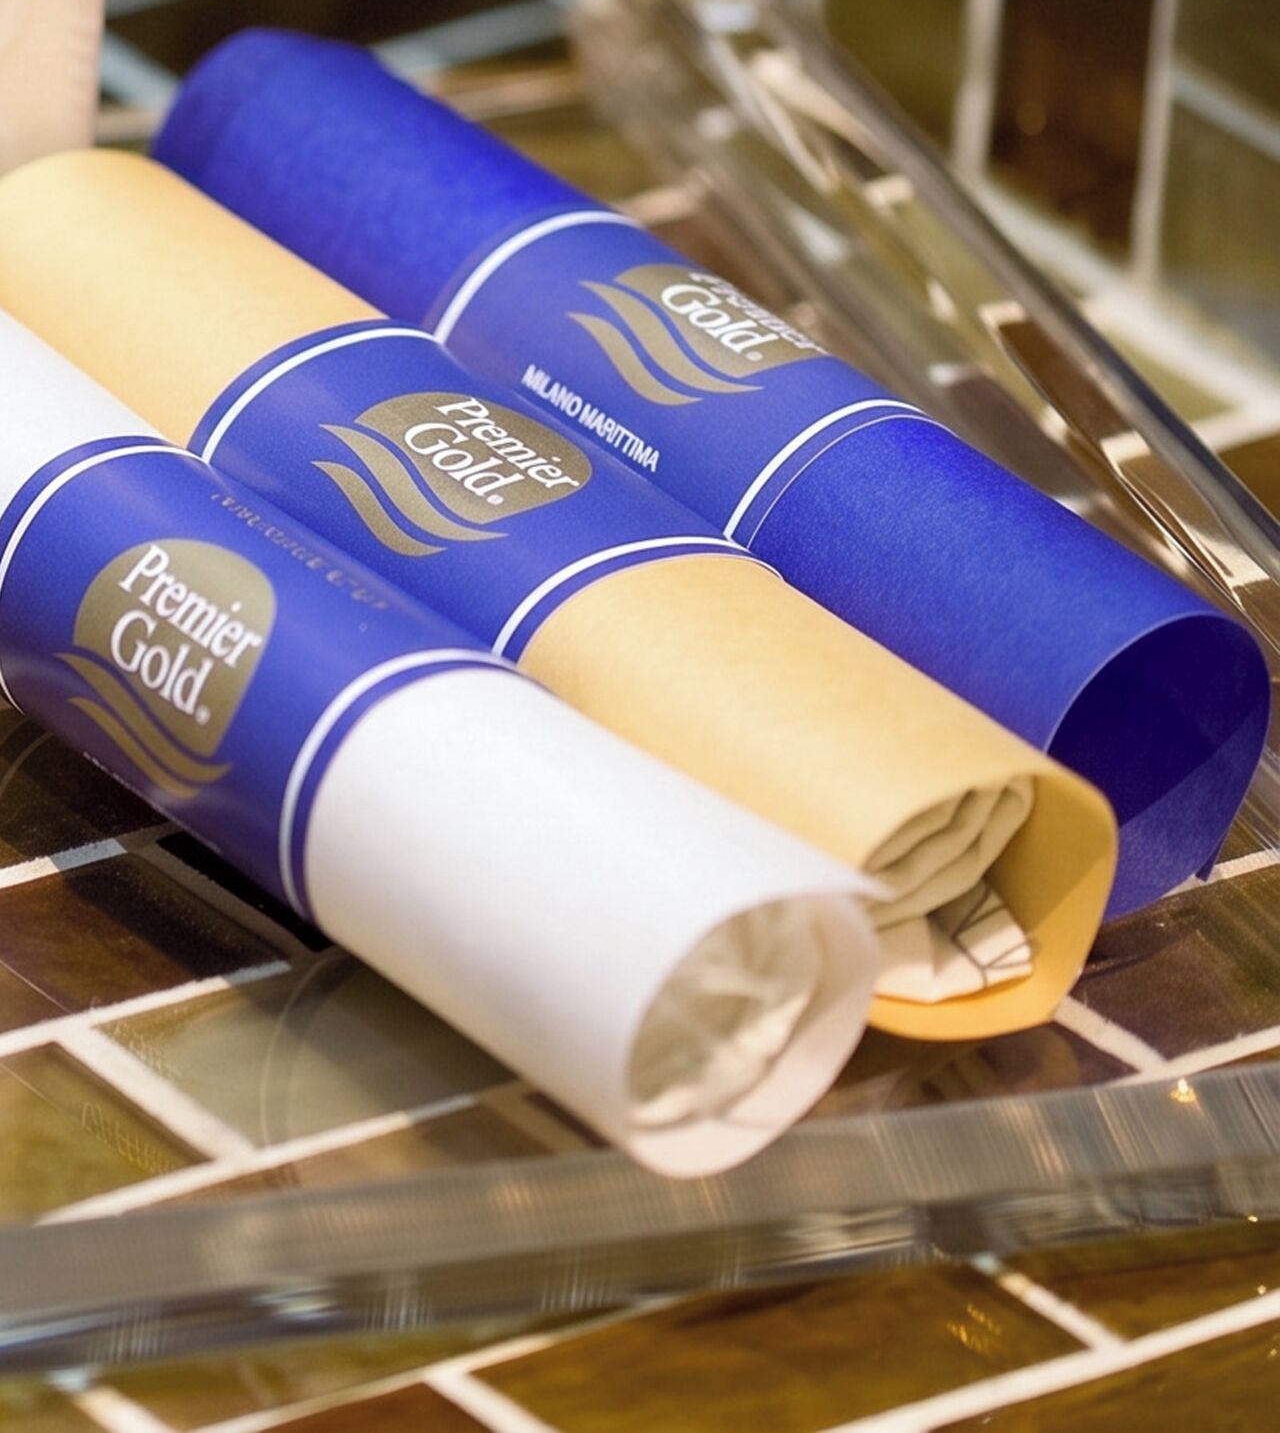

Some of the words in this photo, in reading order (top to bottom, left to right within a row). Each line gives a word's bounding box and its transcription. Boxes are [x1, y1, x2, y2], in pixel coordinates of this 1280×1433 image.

[434, 397, 580, 490] Premier
[521, 364, 582, 417] MILANO
[579, 404, 661, 472] MARITTIMA
[119, 545, 263, 667] Premier
